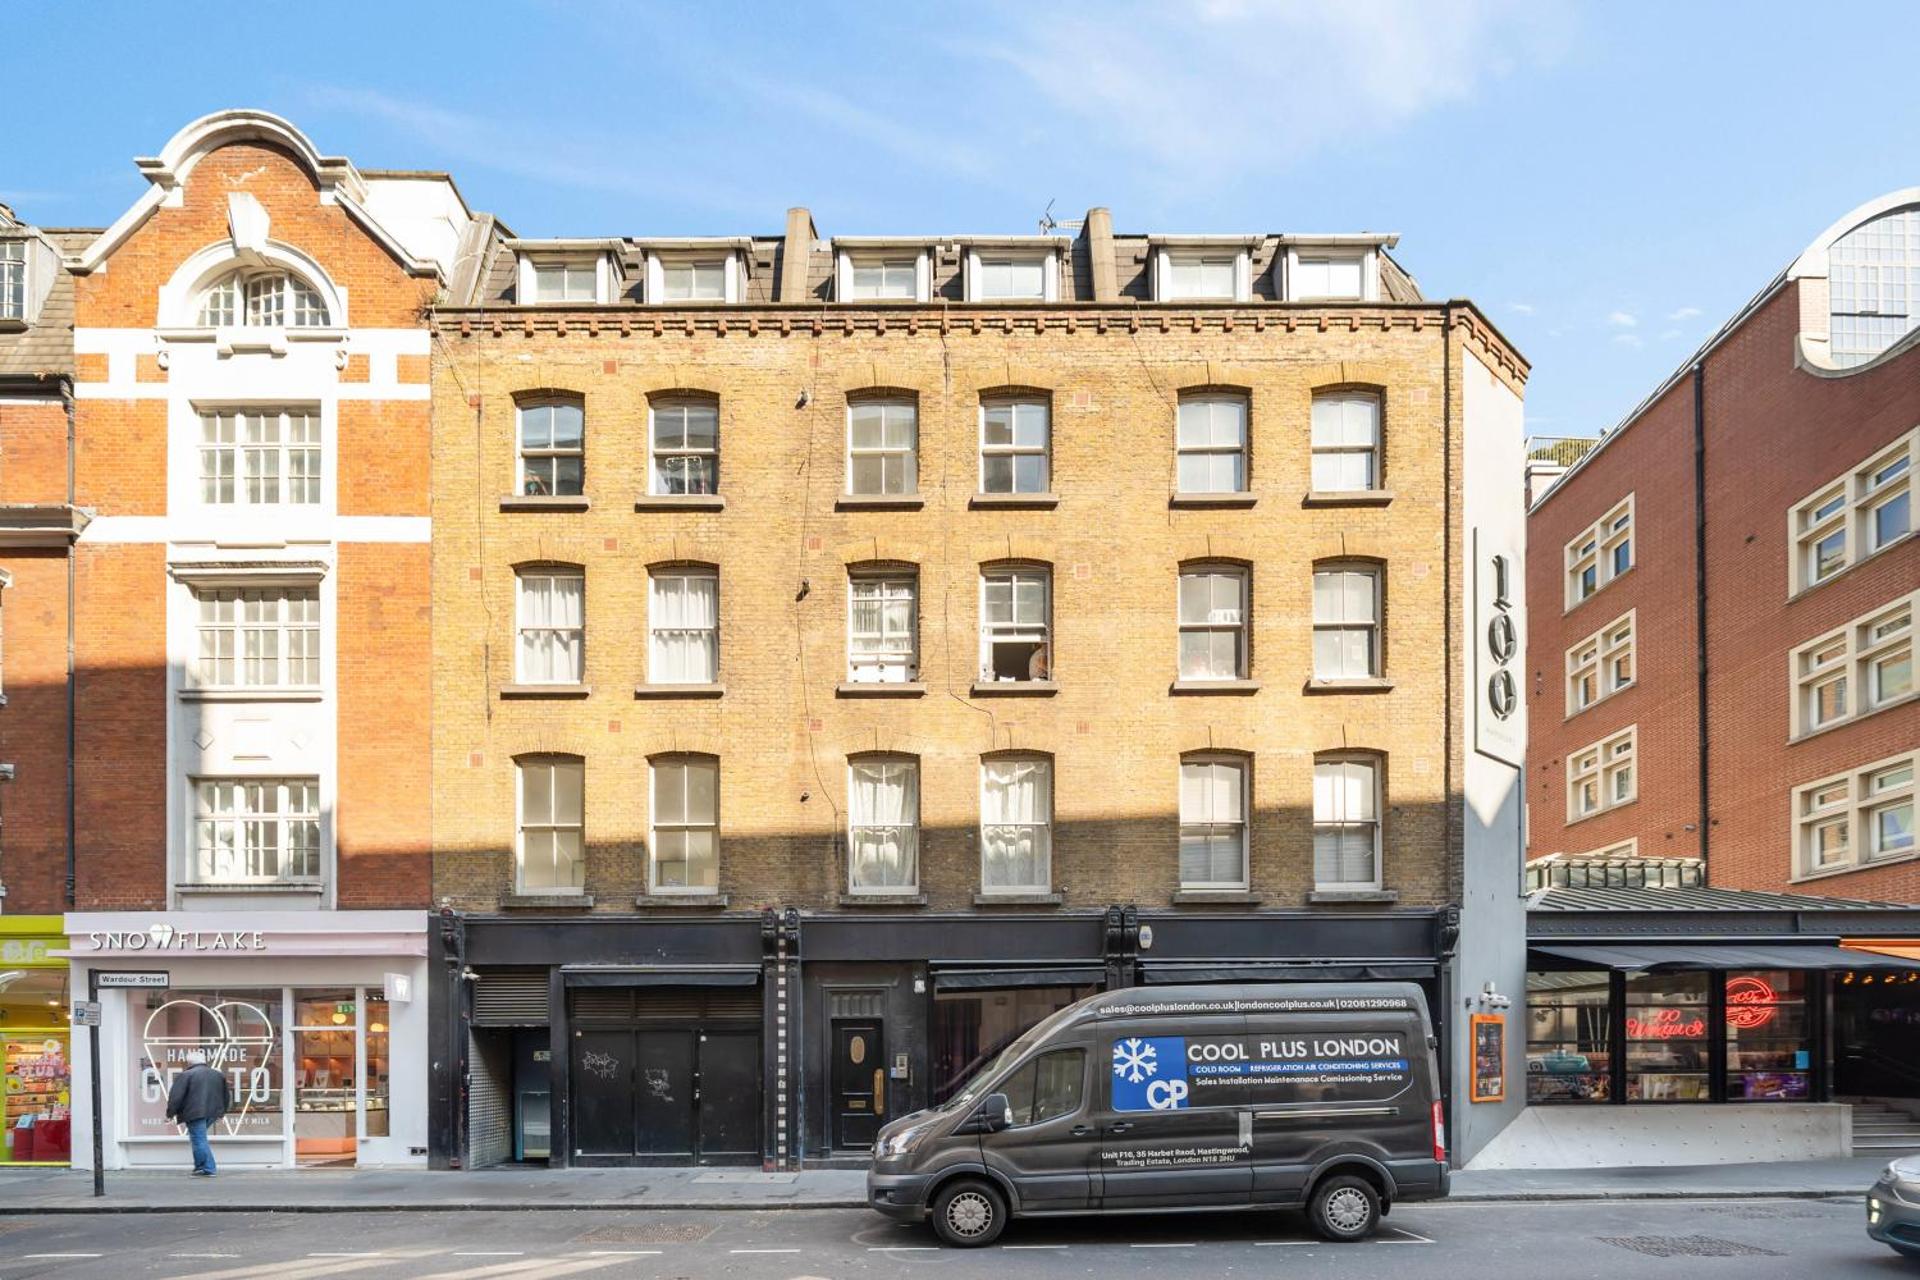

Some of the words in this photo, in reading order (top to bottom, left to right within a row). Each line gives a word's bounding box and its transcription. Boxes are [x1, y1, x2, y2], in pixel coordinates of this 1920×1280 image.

[1488, 554, 1517, 722] 100
[101, 975, 136, 984] Wardour
[138, 975, 165, 984] Street
[1187, 1043, 1250, 1061] COOL
[1260, 1040, 1307, 1058] PLUS
[1313, 1038, 1400, 1057] LONDON
[1195, 1065, 1217, 1073] COLD
[1218, 1065, 1241, 1073] ROOM
[1371, 1062, 1401, 1070] SERVICES
[141, 1066, 270, 1103] GTO
[1196, 1077, 1217, 1086] Sales
[1219, 1077, 1262, 1085] Installation
[1373, 1073, 1403, 1082] Service
[1146, 1079, 1189, 1111] CP
[1101, 1152, 1119, 1160] Unit
[1173, 1156, 1201, 1164] London
